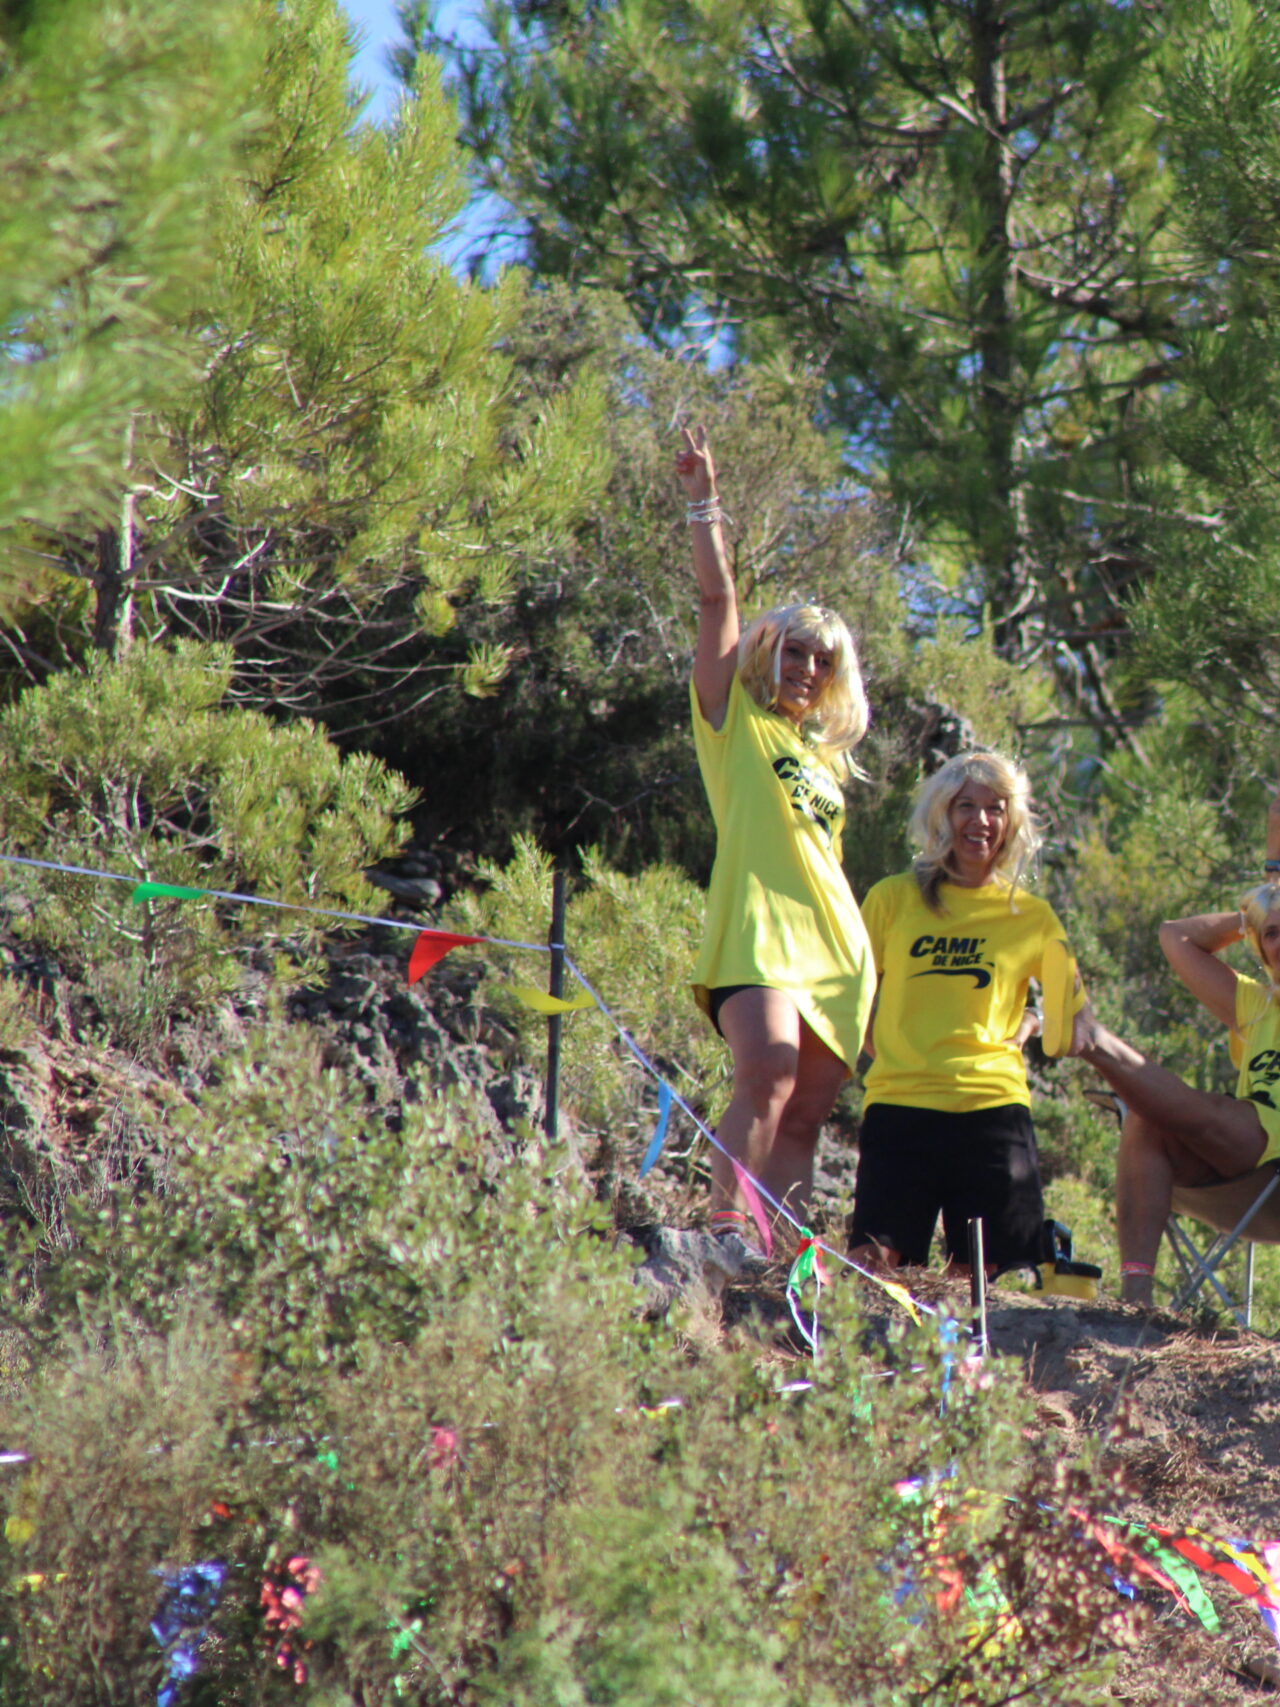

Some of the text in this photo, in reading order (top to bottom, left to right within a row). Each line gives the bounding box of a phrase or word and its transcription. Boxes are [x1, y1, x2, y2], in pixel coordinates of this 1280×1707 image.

[809, 793, 840, 821] NICE
[909, 935, 986, 958] CAMI'
[931, 952, 984, 967] DE NICE
